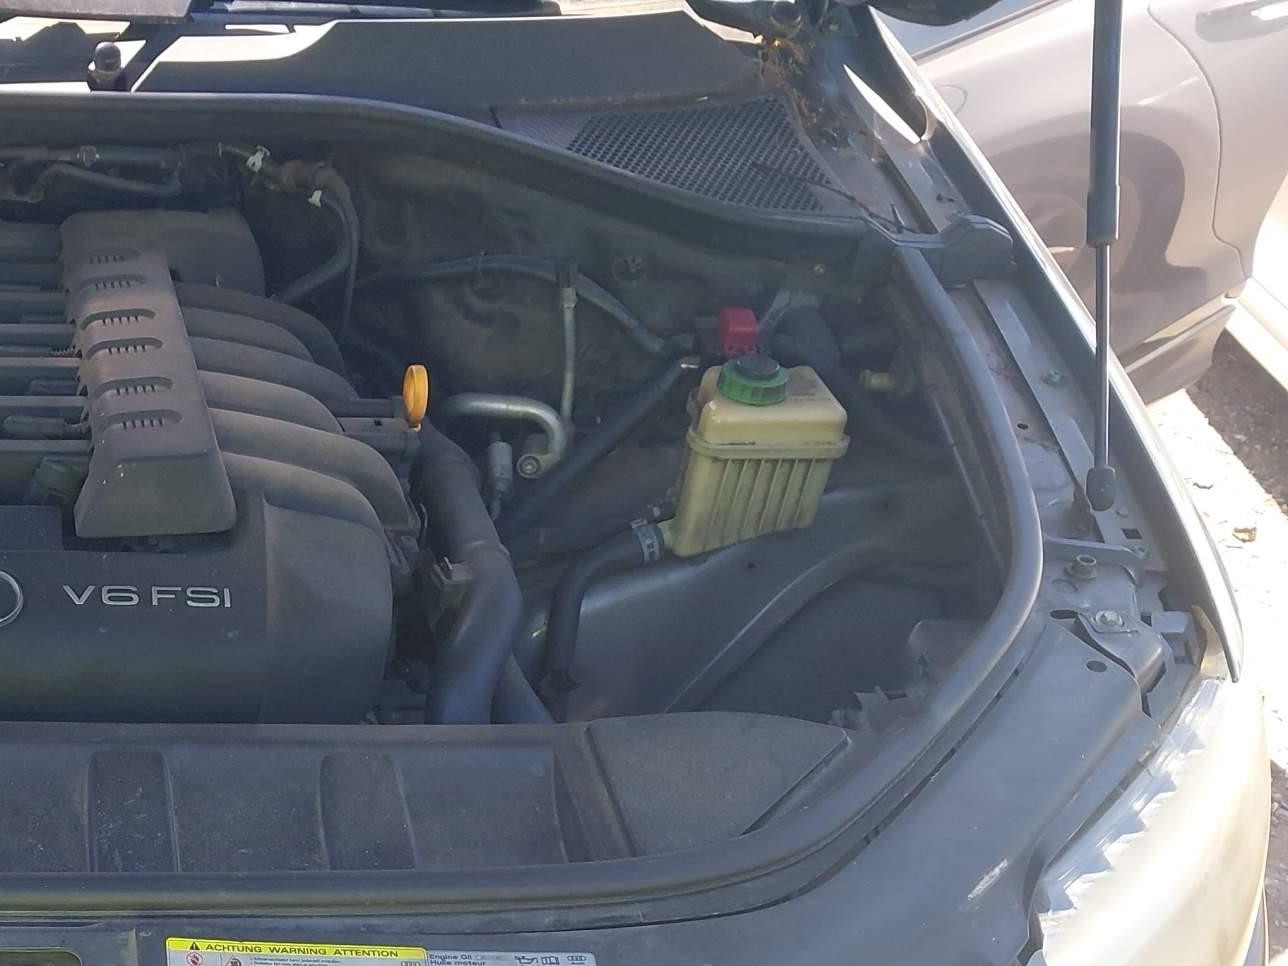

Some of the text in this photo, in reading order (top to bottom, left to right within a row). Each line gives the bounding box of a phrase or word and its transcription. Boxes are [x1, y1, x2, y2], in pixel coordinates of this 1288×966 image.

[63, 585, 231, 608] V6 FSI
[205, 944, 399, 957] ACHTUNG WARNING ATTENTION
